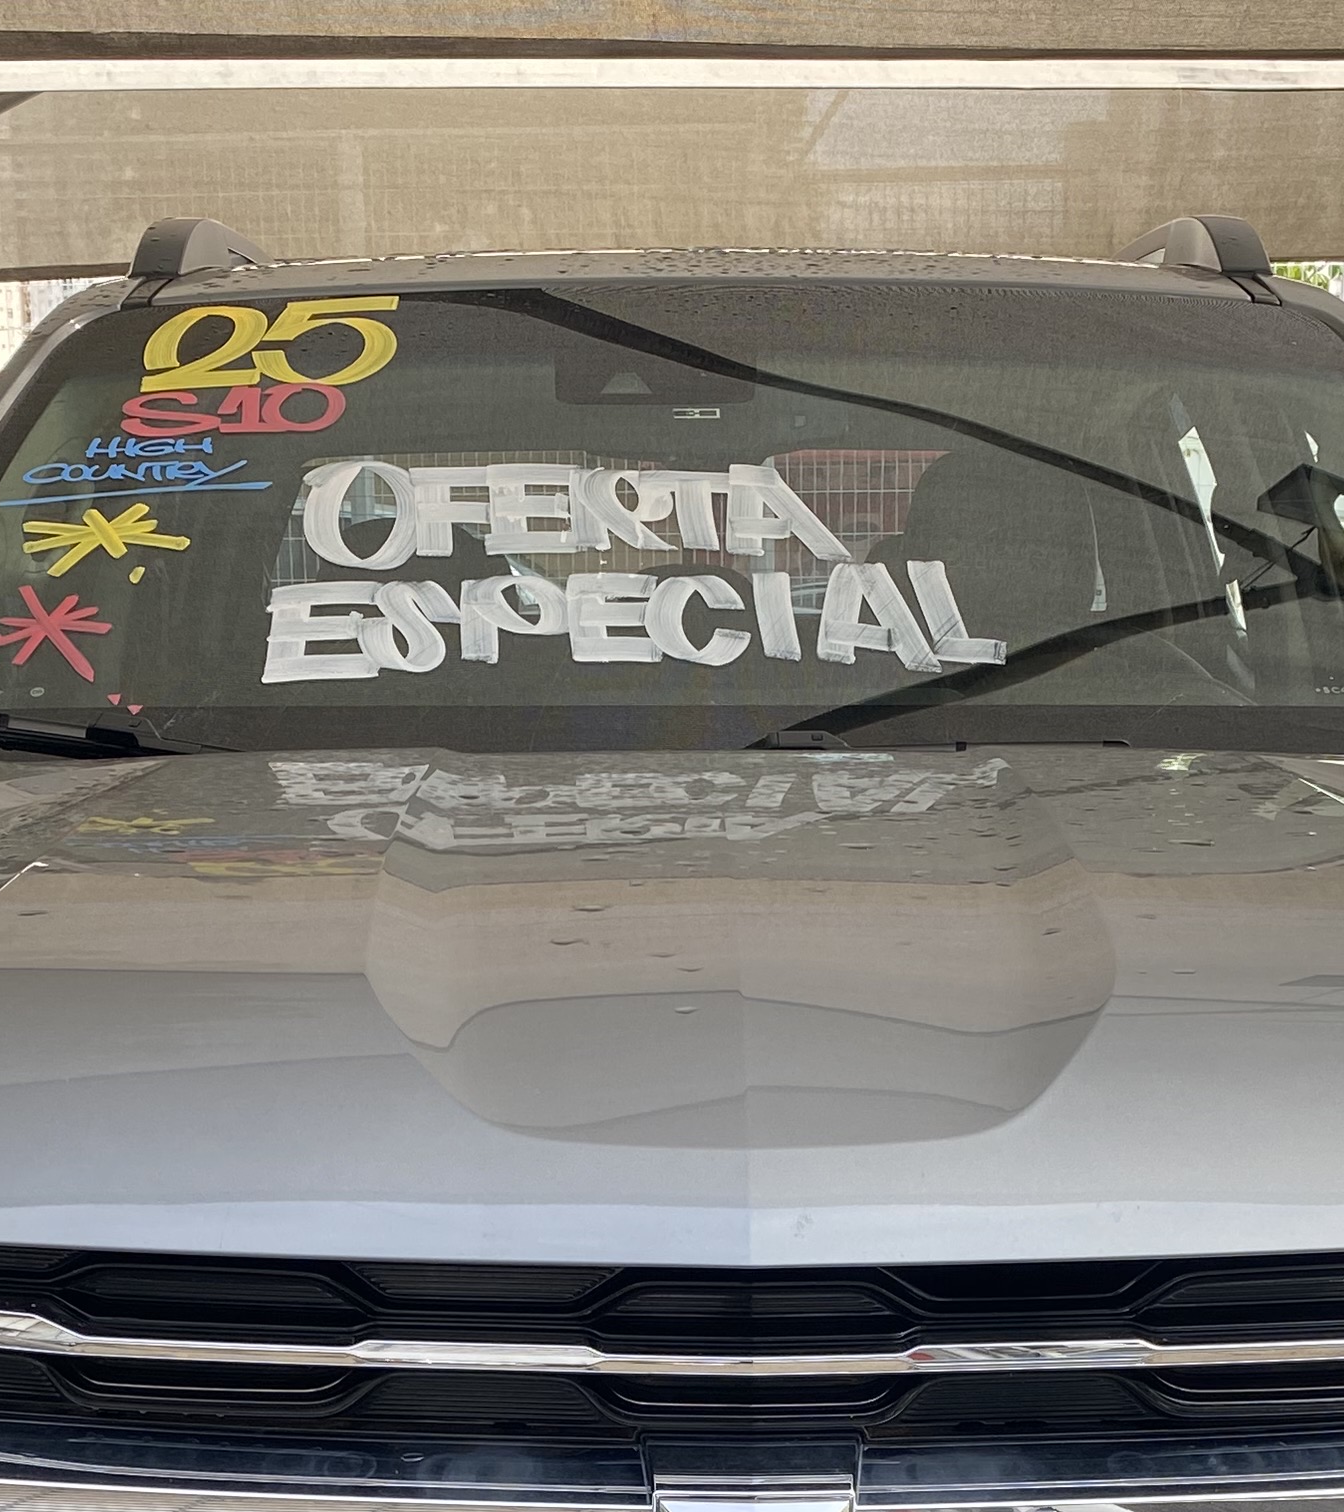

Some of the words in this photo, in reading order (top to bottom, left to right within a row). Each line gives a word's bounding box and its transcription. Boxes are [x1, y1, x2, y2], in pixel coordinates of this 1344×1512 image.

[140, 296, 399, 393] 25
[85, 436, 213, 458] HIGH
[121, 383, 346, 437] S10
[23, 460, 248, 488] COUNTRY
[303, 461, 853, 570] OFERTA
[260, 560, 1007, 684] ESPECIAL
